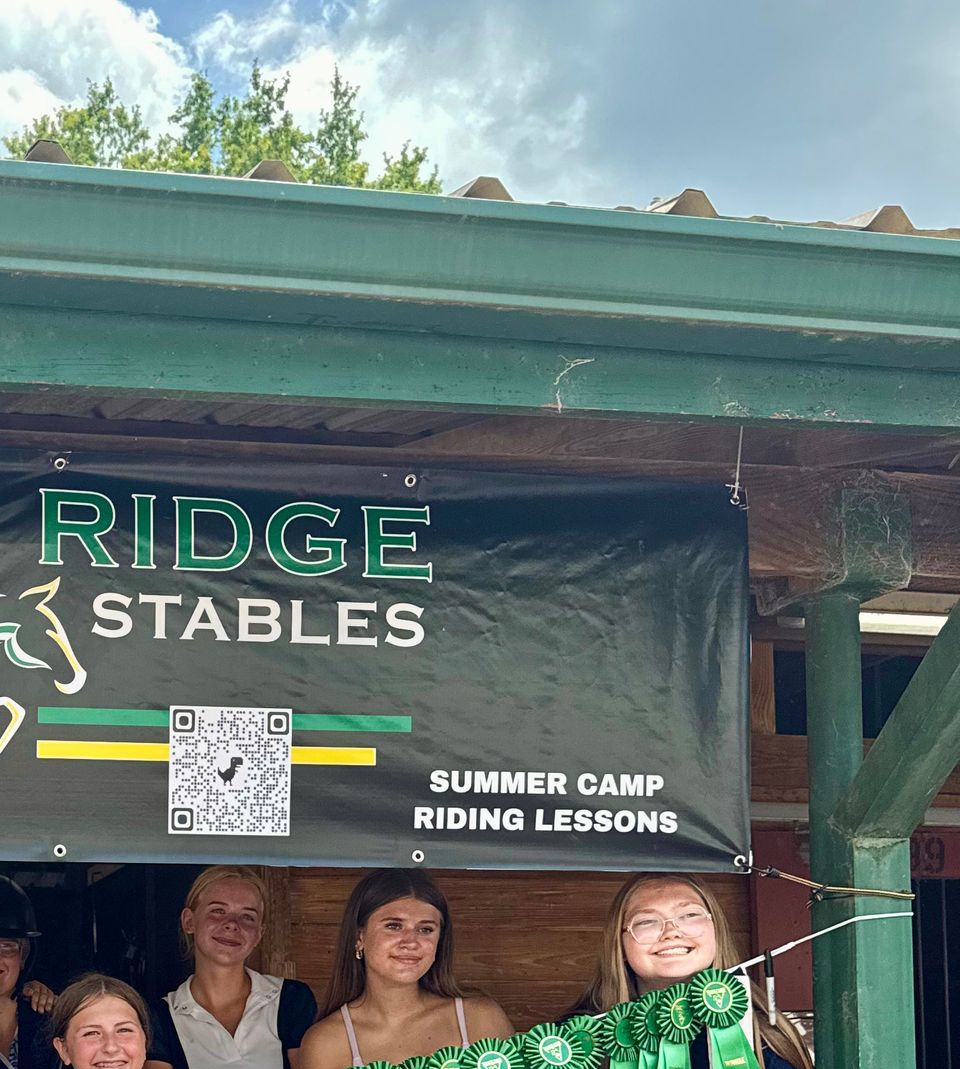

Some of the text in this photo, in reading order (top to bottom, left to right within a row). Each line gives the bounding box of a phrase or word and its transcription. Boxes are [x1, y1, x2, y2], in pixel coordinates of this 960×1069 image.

[39, 488, 432, 582] RIDGE
[91, 592, 425, 647] STABLES
[429, 770, 665, 797] SUMMER CAMP
[413, 806, 679, 833] RIDING LESSONS
